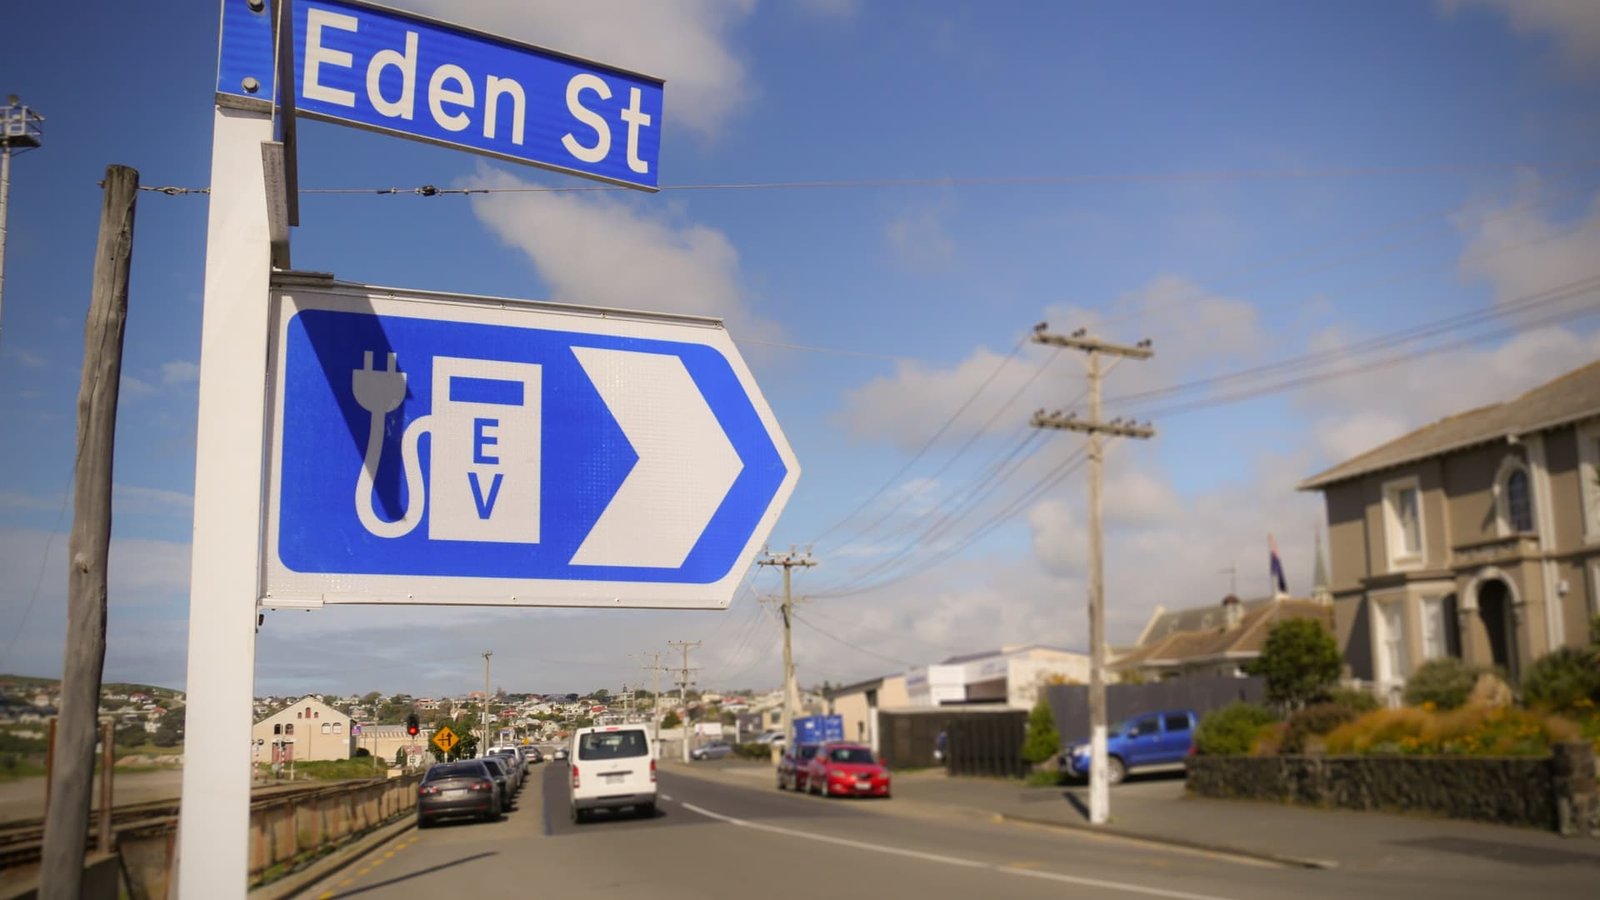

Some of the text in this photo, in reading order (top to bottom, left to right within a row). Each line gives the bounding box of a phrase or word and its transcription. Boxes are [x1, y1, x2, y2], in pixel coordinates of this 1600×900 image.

[302, 7, 651, 174] Eden St
[468, 417, 504, 520] EV
